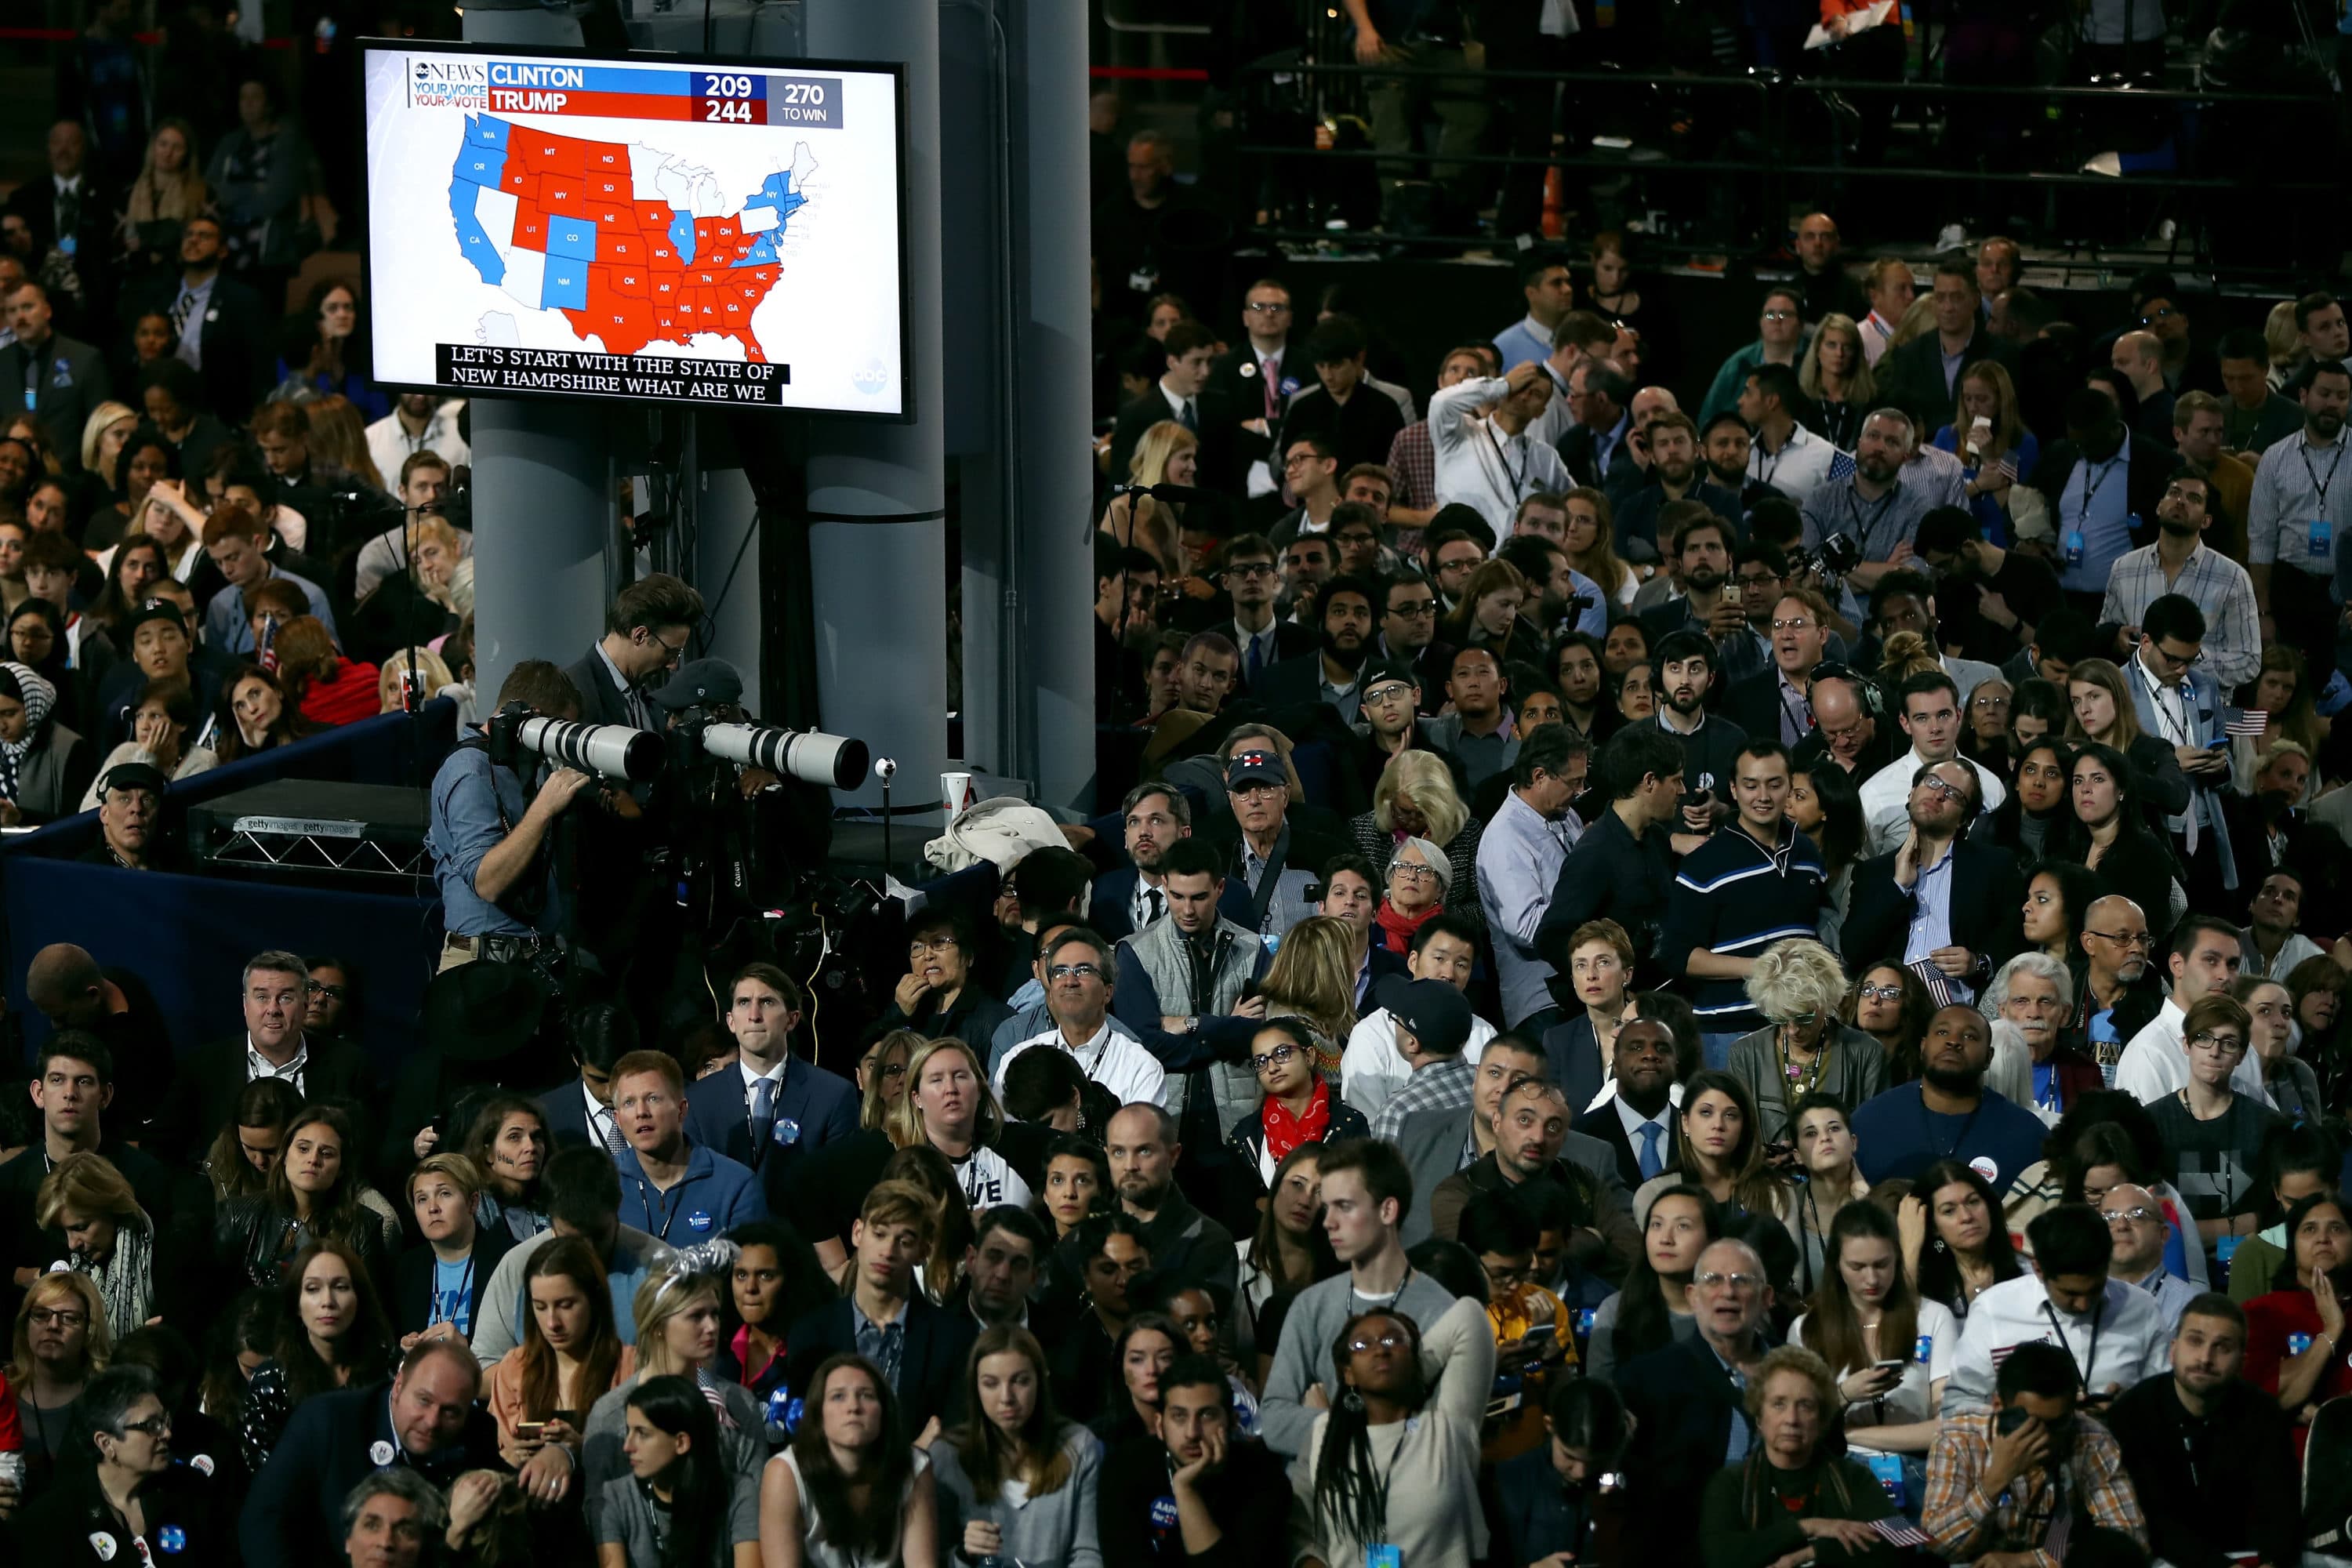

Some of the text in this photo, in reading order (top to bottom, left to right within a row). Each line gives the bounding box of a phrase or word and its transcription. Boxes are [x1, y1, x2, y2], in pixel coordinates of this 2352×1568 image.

[430, 64, 485, 82] NEWS
[491, 64, 583, 88] CLINTON
[414, 82, 486, 96] YOUR VOICE
[706, 74, 752, 98] 209
[784, 84, 824, 105] 270
[414, 94, 487, 108] YOUR VOTE
[491, 90, 568, 112] TRUMP
[706, 100, 752, 123] 244
[782, 107, 826, 122] TO WIN
[604, 183, 614, 192] SD
[451, 346, 774, 380] LET'S START WITH THE STATE OF
[452, 367, 765, 401] NEW HAMPSHIRE WHAT ARE WE
[248, 819, 298, 831] gettyimages
[303, 822, 353, 833] gettyimages
